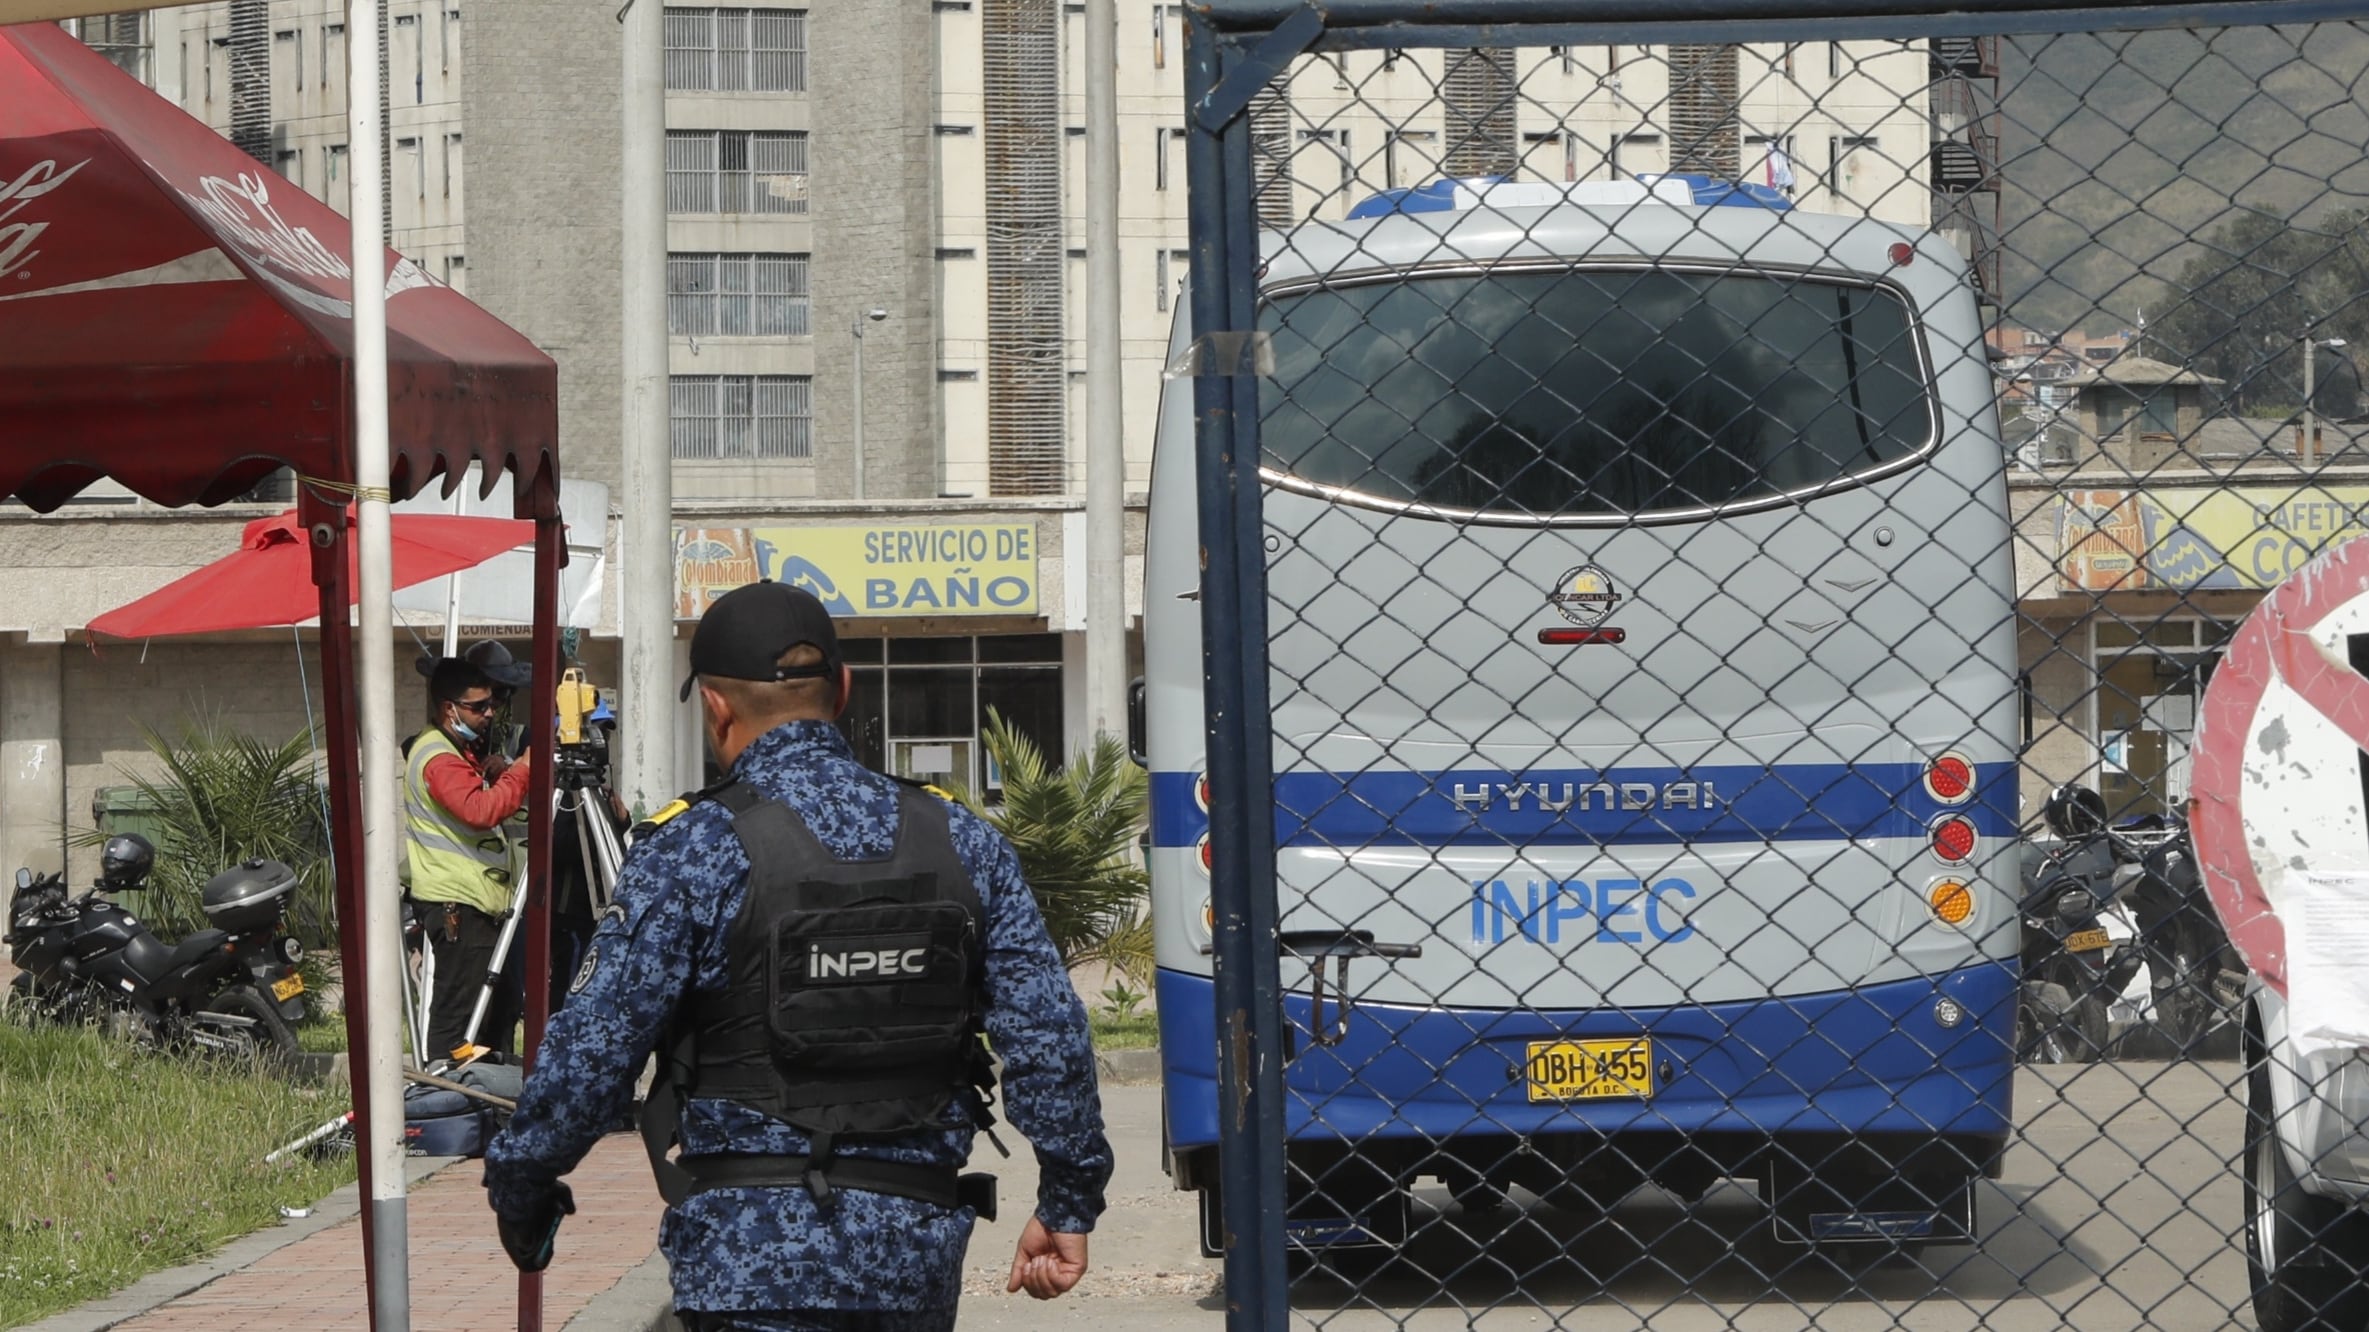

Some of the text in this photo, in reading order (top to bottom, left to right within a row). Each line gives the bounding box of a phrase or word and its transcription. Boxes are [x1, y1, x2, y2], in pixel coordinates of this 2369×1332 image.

[864, 528, 1030, 564] SERVICIO DE
[2253, 536, 2348, 581] CO
[681, 558, 752, 594] Colombiana
[865, 566, 1031, 609] BAÑO
[443, 625, 533, 636] COMIENDA
[1454, 781, 1714, 812] HYUNDAI
[1471, 877, 1697, 945] INPEC
[1594, 1048, 1647, 1082] 455
